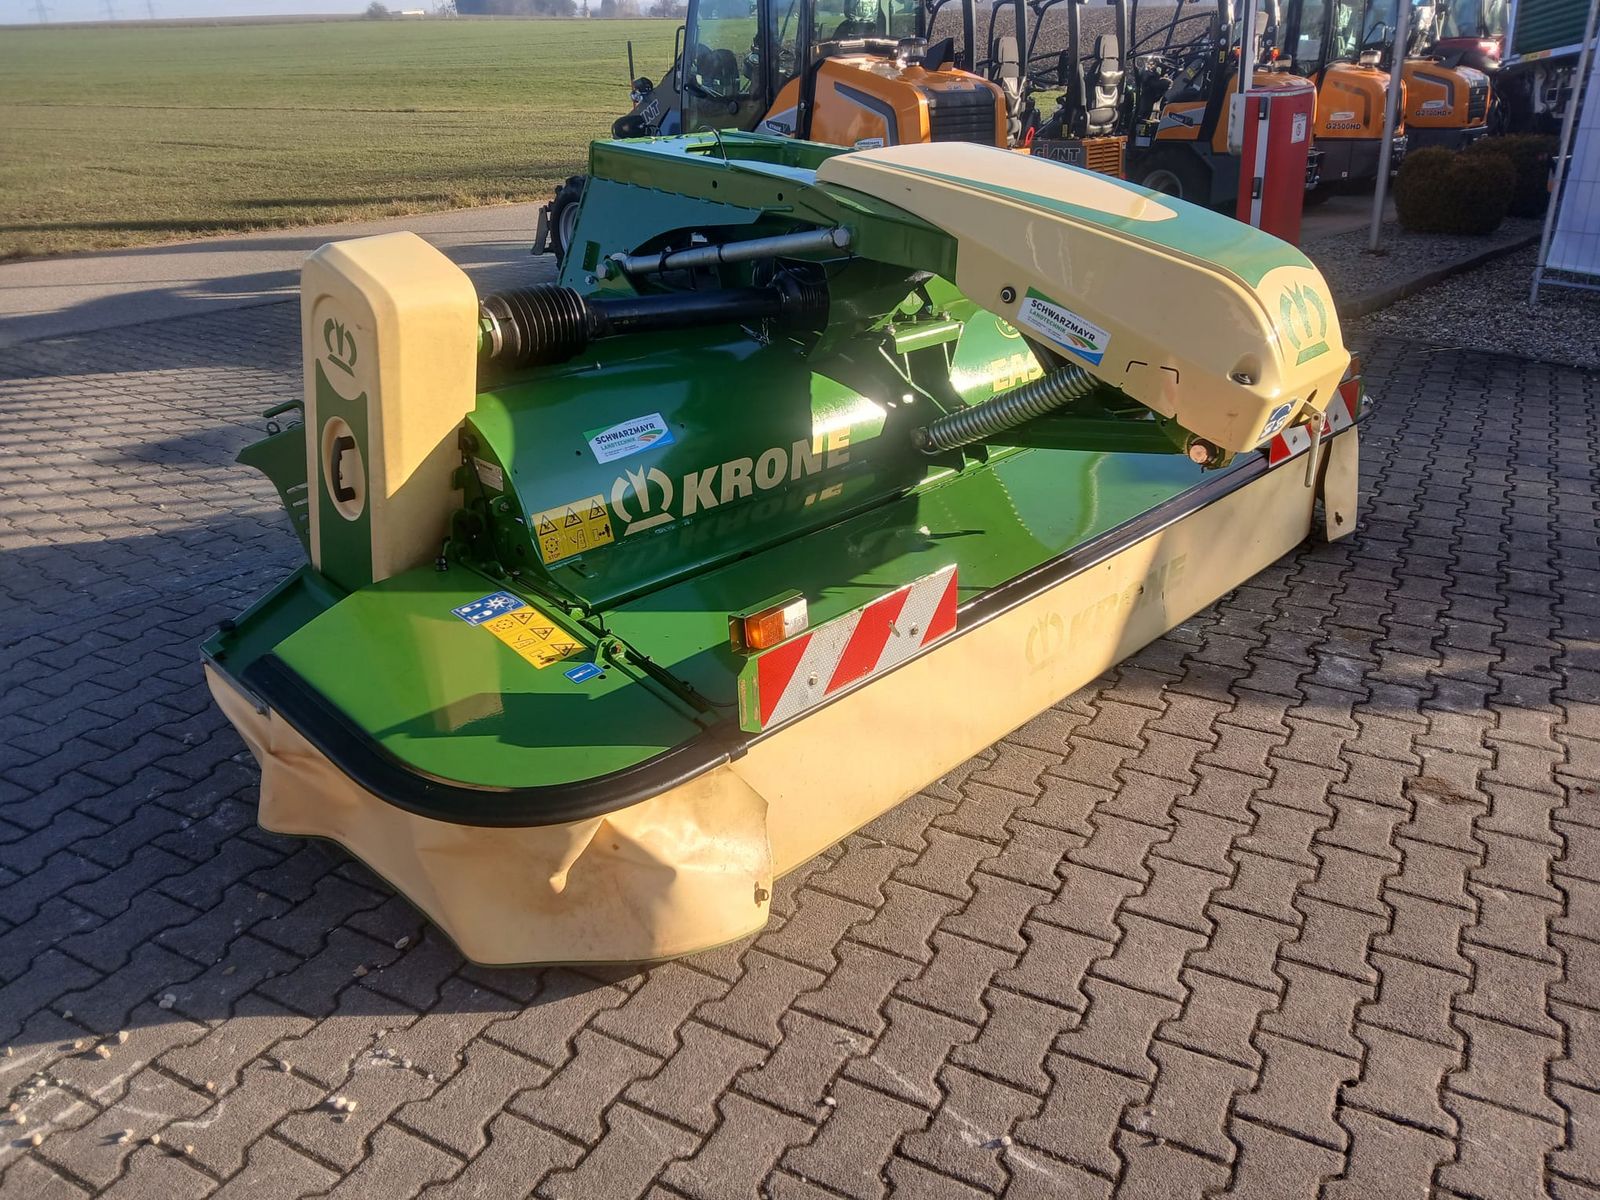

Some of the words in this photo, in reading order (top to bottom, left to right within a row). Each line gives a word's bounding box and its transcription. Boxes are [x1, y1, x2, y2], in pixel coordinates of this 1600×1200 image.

[1029, 308, 1066, 335] LANDTECHNIK
[1031, 299, 1096, 342] SCHWARZMAYR
[595, 422, 656, 445] SCHWARZMAYR
[682, 425, 851, 517] KRONE
